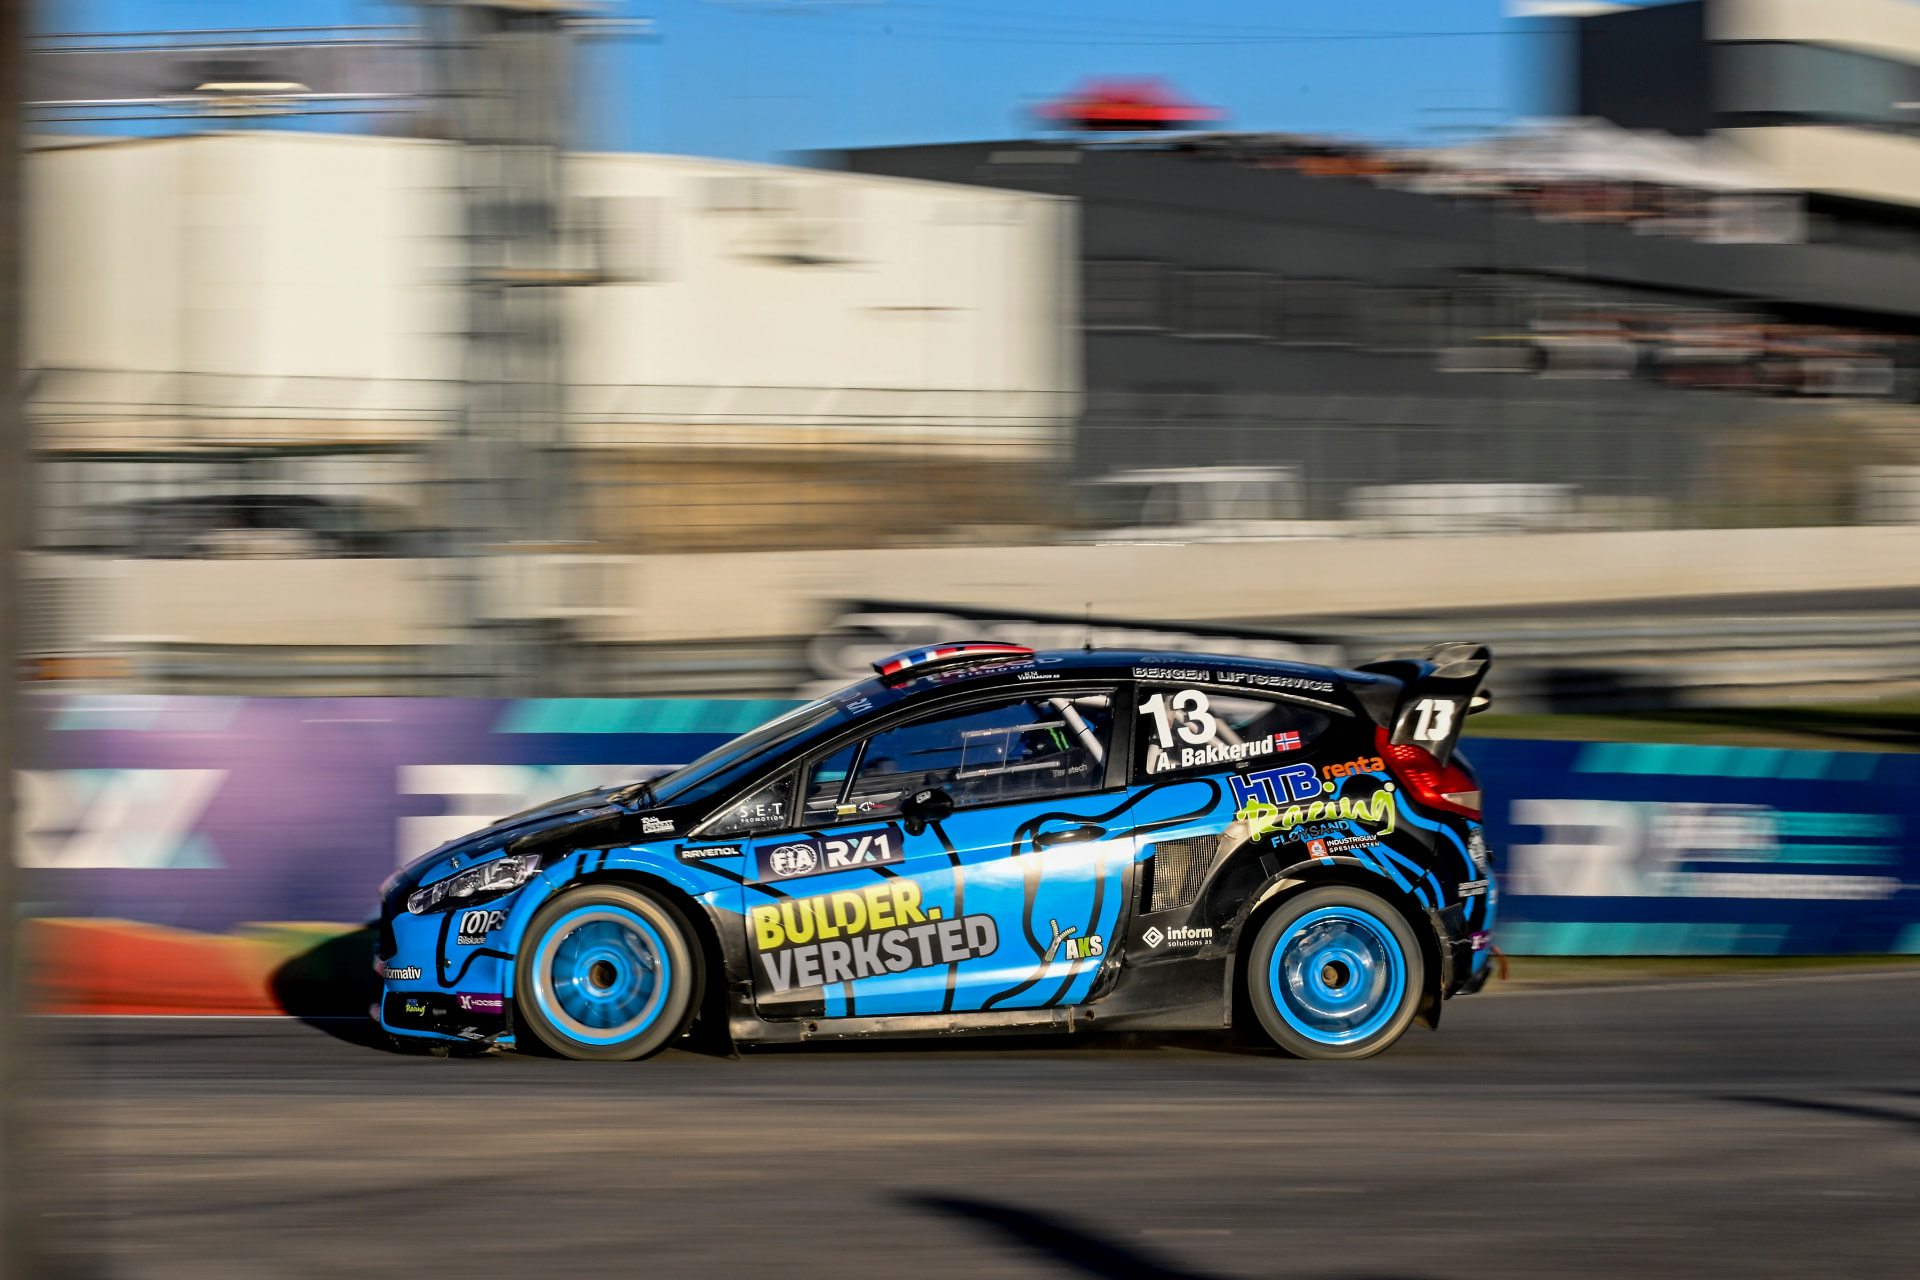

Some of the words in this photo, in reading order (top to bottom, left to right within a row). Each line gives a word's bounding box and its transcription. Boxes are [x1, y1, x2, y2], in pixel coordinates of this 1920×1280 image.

[1132, 667, 1210, 681] BERGEN
[1216, 671, 1335, 692] LIFTSERVICE
[1138, 689, 1217, 749] 13
[1413, 698, 1456, 741] 13
[1156, 752, 1177, 772] A.
[1181, 735, 1273, 768] Bakkerud
[1322, 756, 1386, 780] renta
[740, 815, 785, 823] PROMOTION
[1236, 782, 1396, 841] Racing
[1271, 820, 1350, 848] FLØYSAND
[1326, 834, 1377, 847] INDUSTRIGULV
[682, 847, 739, 859] RAVENOL
[825, 834, 891, 868] RX1
[1328, 841, 1380, 853] SPESIALISTEN
[751, 881, 942, 950] BULDER.
[1167, 926, 1213, 940] inform
[1167, 940, 1203, 948] solutions
[760, 915, 997, 993] VERKSTED
[1066, 935, 1103, 960] AKS
